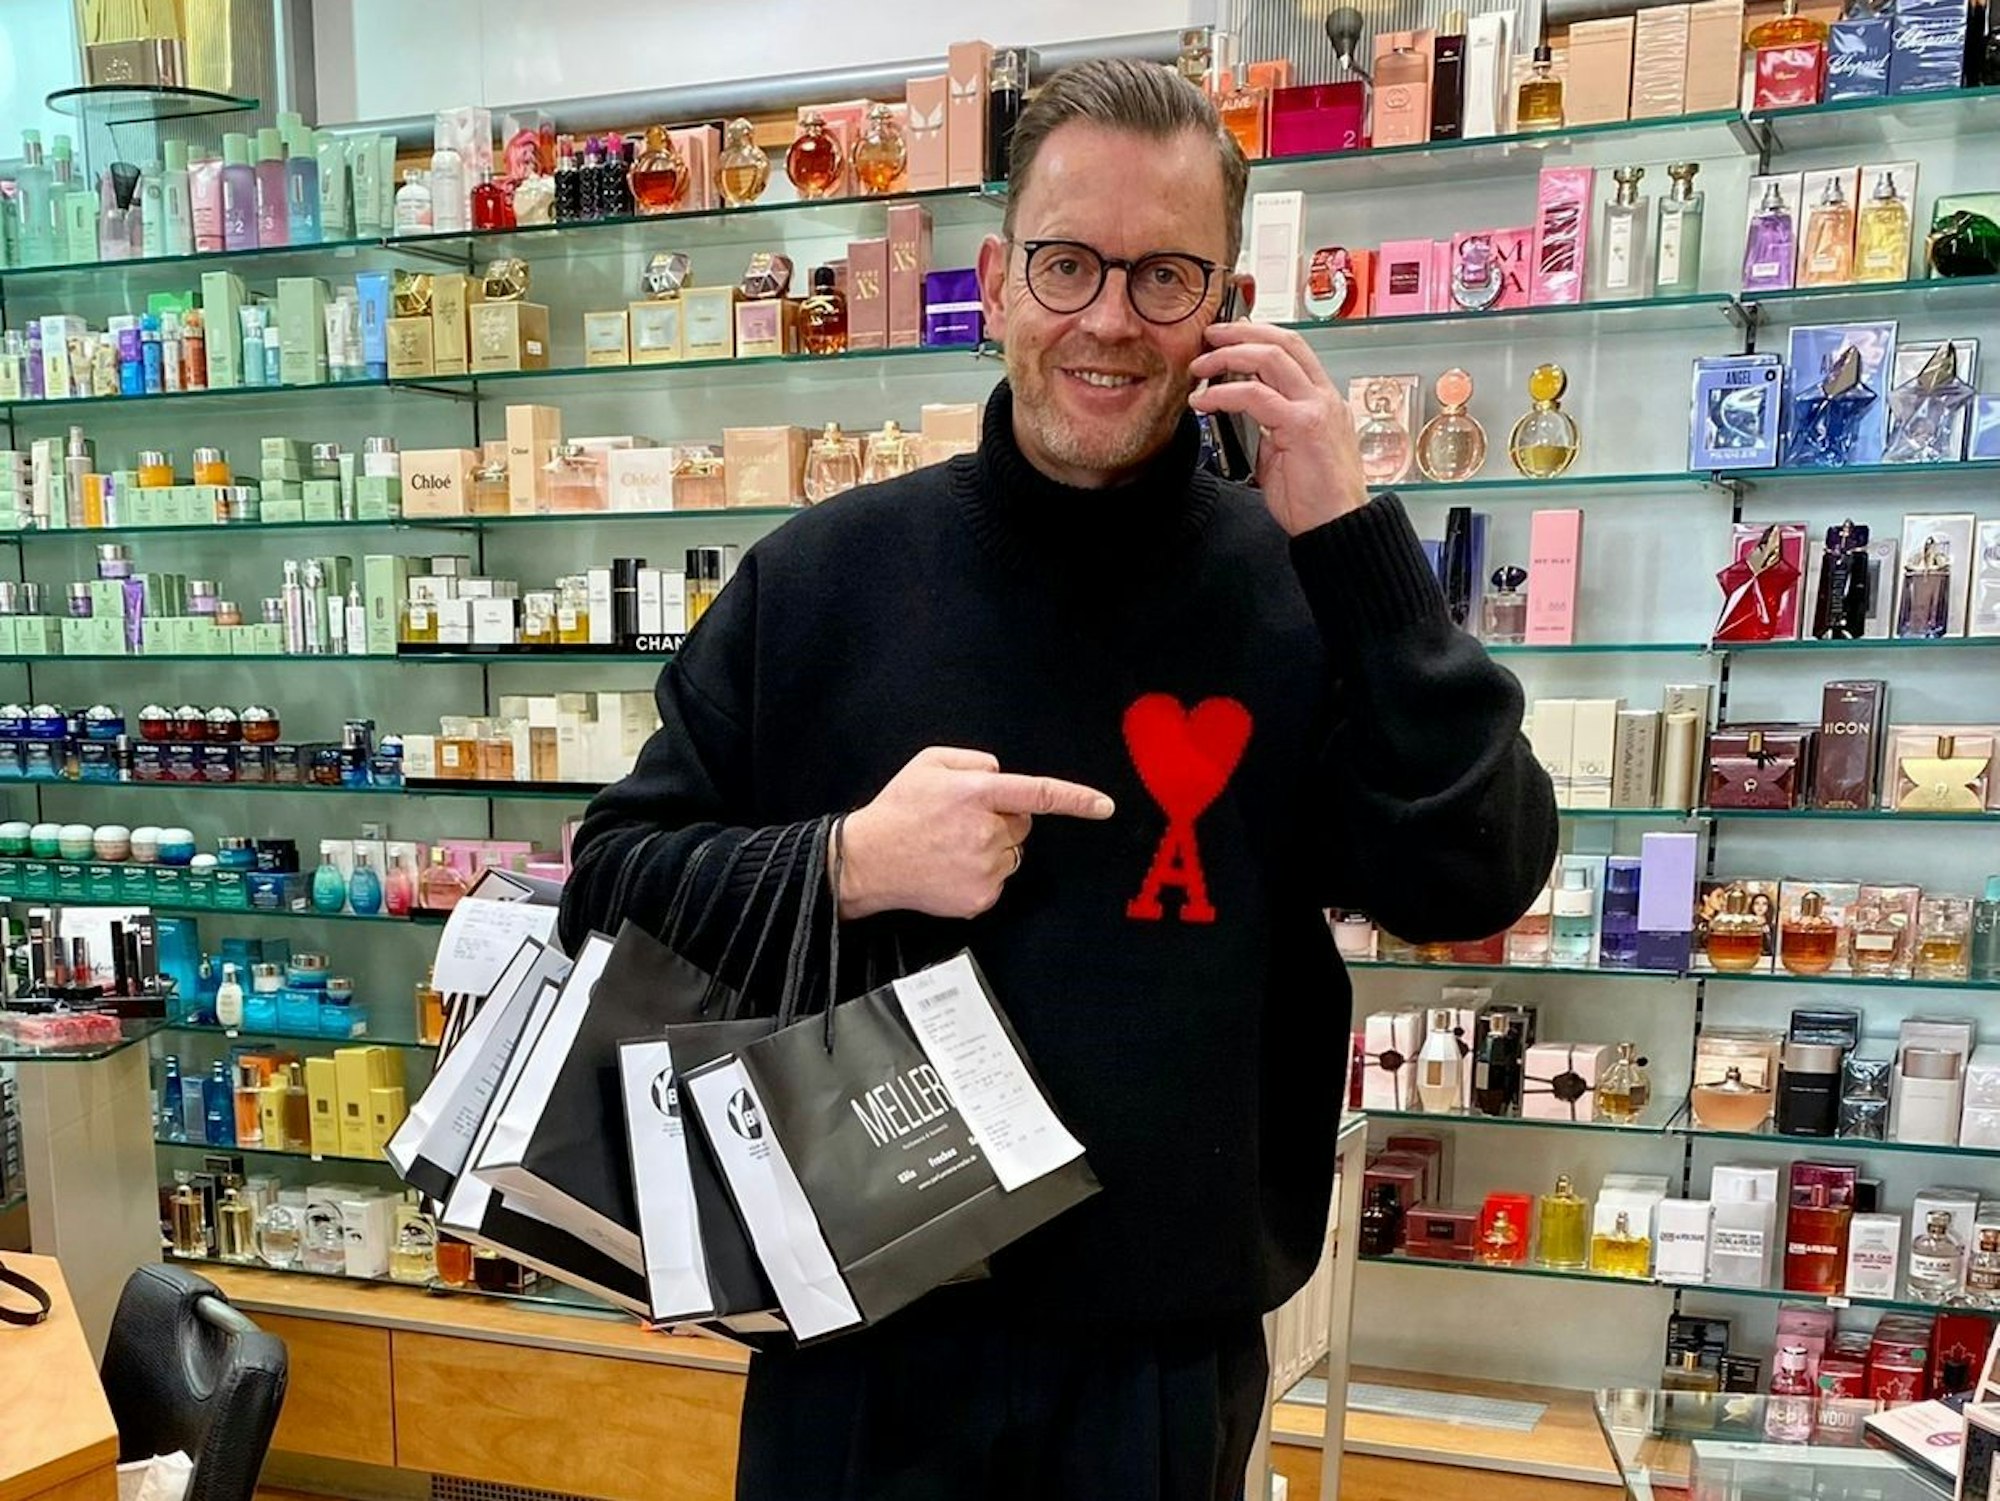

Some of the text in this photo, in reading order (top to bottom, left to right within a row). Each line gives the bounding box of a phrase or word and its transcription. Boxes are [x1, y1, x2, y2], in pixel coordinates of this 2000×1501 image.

[1827, 53, 1891, 79] Chopard
[1343, 130, 1357, 149] 2
[234, 219, 245, 234] 2
[265, 216, 274, 230] 3
[1725, 370, 1752, 385] ANGEL
[411, 473, 452, 492] Chloé
[620, 472, 661, 488] Chloé
